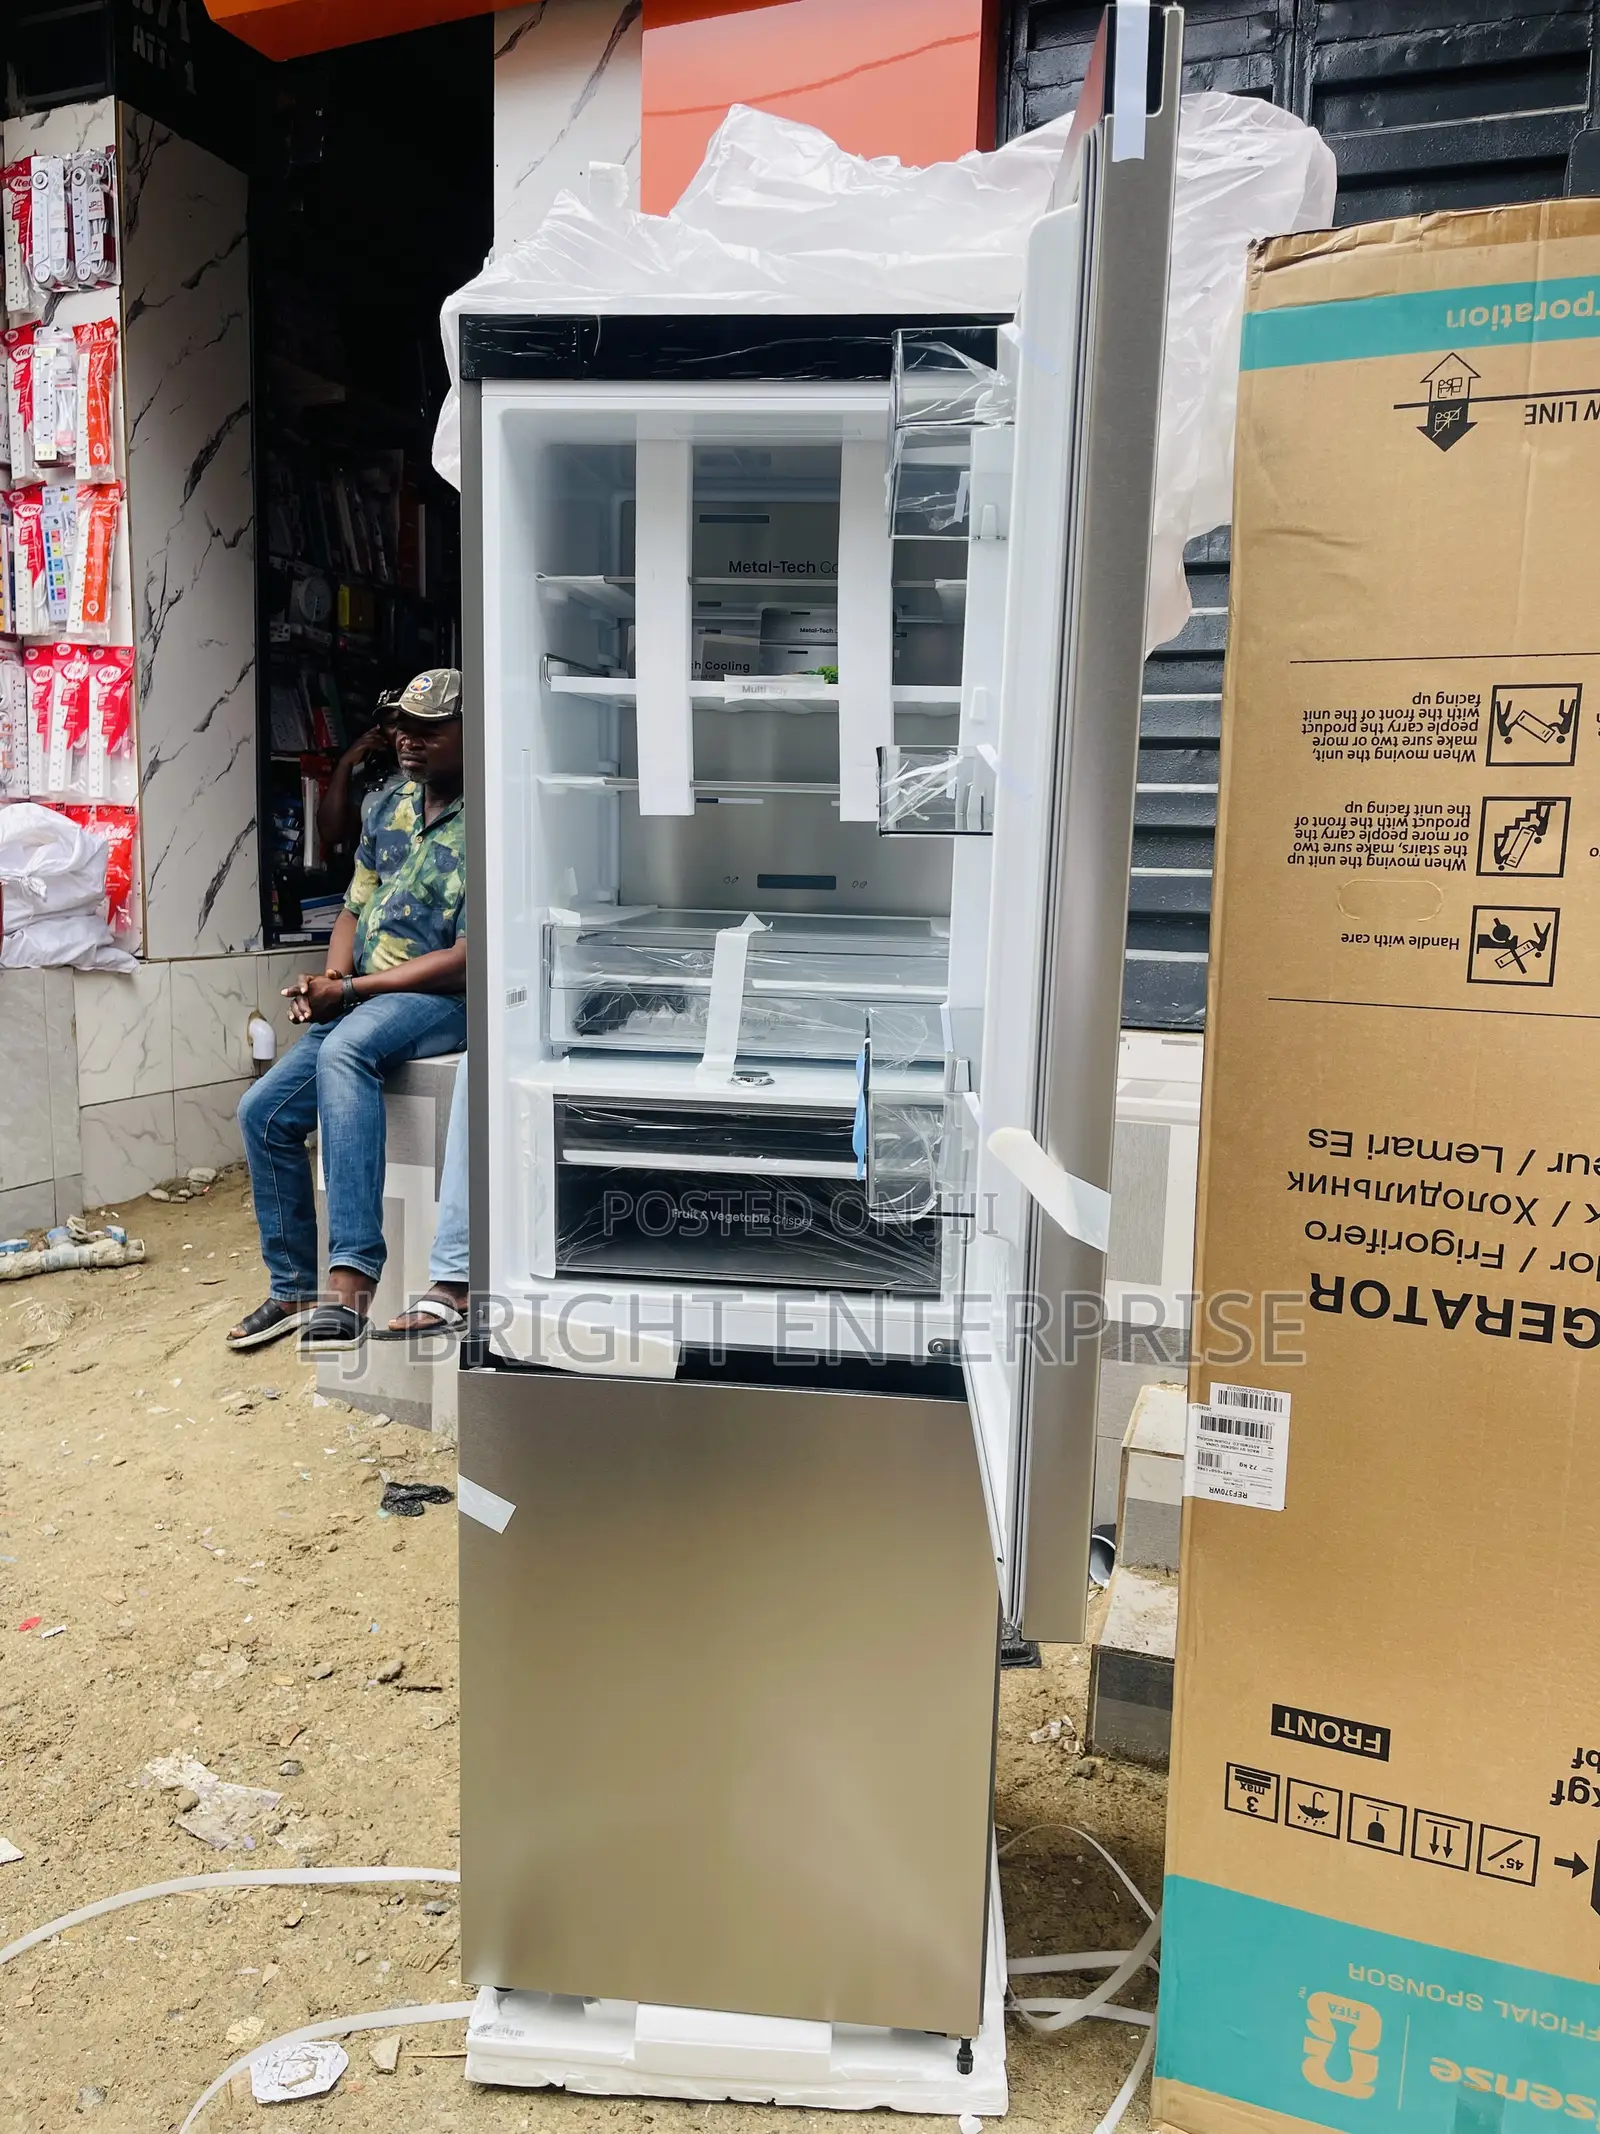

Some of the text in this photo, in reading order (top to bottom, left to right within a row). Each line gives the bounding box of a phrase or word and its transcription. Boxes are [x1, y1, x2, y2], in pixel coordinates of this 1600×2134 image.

[15, 179, 31, 187] itel
[1446, 290, 1600, 330] poration
[1524, 401, 1577, 425] LINE
[728, 560, 816, 574] Metal-Tech
[705, 661, 750, 672] Cooling
[742, 684, 767, 694] Multi
[1412, 692, 1481, 707] facing up
[1303, 708, 1479, 722] with the front of the unit
[1301, 719, 1479, 736] people carry the product
[1312, 736, 1477, 748] make sure two or more
[1312, 747, 1476, 762] When moving the unit,
[1345, 801, 1471, 817] the unit facing up
[1294, 815, 1470, 830] product with the front of
[1295, 827, 1469, 842] or more people carry the
[1293, 842, 1468, 858] the stairs, make sure two
[1287, 852, 1466, 871] When moving the unit up
[1341, 933, 1460, 950] Handle with care
[1308, 1128, 1354, 1158] Es
[1367, 1134, 1504, 1174] Lemari
[1547, 1152, 1600, 1176] ur
[1286, 1170, 1539, 1227] Холодильник
[671, 1207, 814, 1229] Fruit & Vegetable Crisper
[1304, 1220, 1505, 1270] Frigorifero
[1550, 1251, 1600, 1280] or
[1309, 1272, 1600, 1350] GERATOR
[1208, 1486, 1248, 1499] REF370WR
[1277, 1711, 1382, 1753] FRONT
[1239, 1782, 1266, 1796] max
[1246, 1796, 1259, 1813] 3
[1348, 1963, 1484, 2012] SPONSOR
[1327, 2002, 1361, 2021] FIFA
[1429, 2056, 1600, 2130] sense
